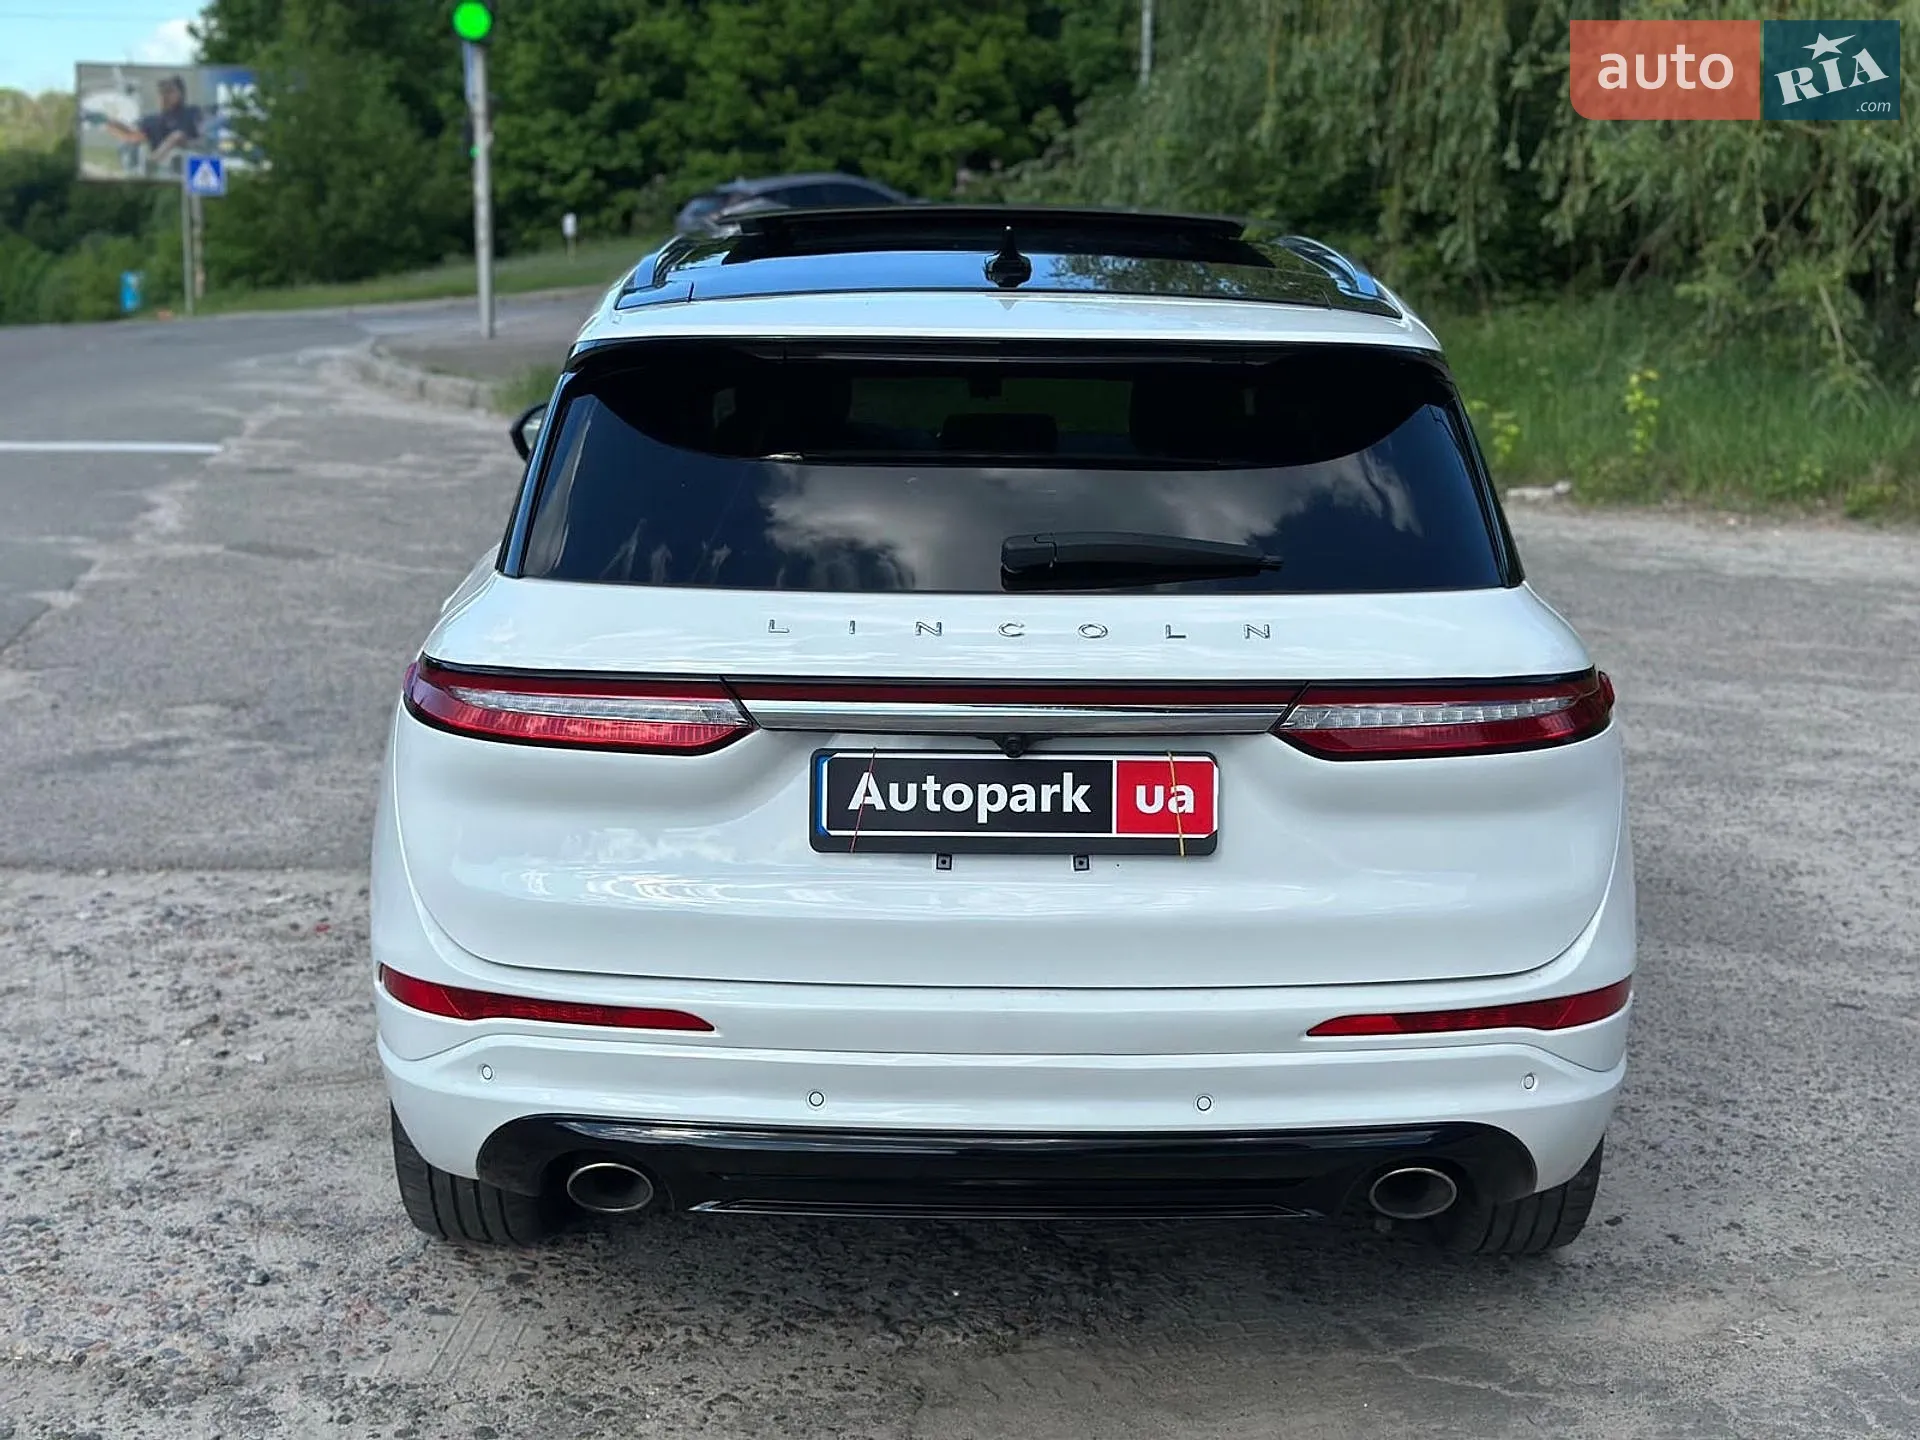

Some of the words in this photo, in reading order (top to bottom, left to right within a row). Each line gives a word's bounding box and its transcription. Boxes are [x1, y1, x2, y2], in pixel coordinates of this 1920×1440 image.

[767, 618, 1272, 640] LINCOLN
[847, 771, 1092, 824] Autopark
[1134, 783, 1196, 814] ua
